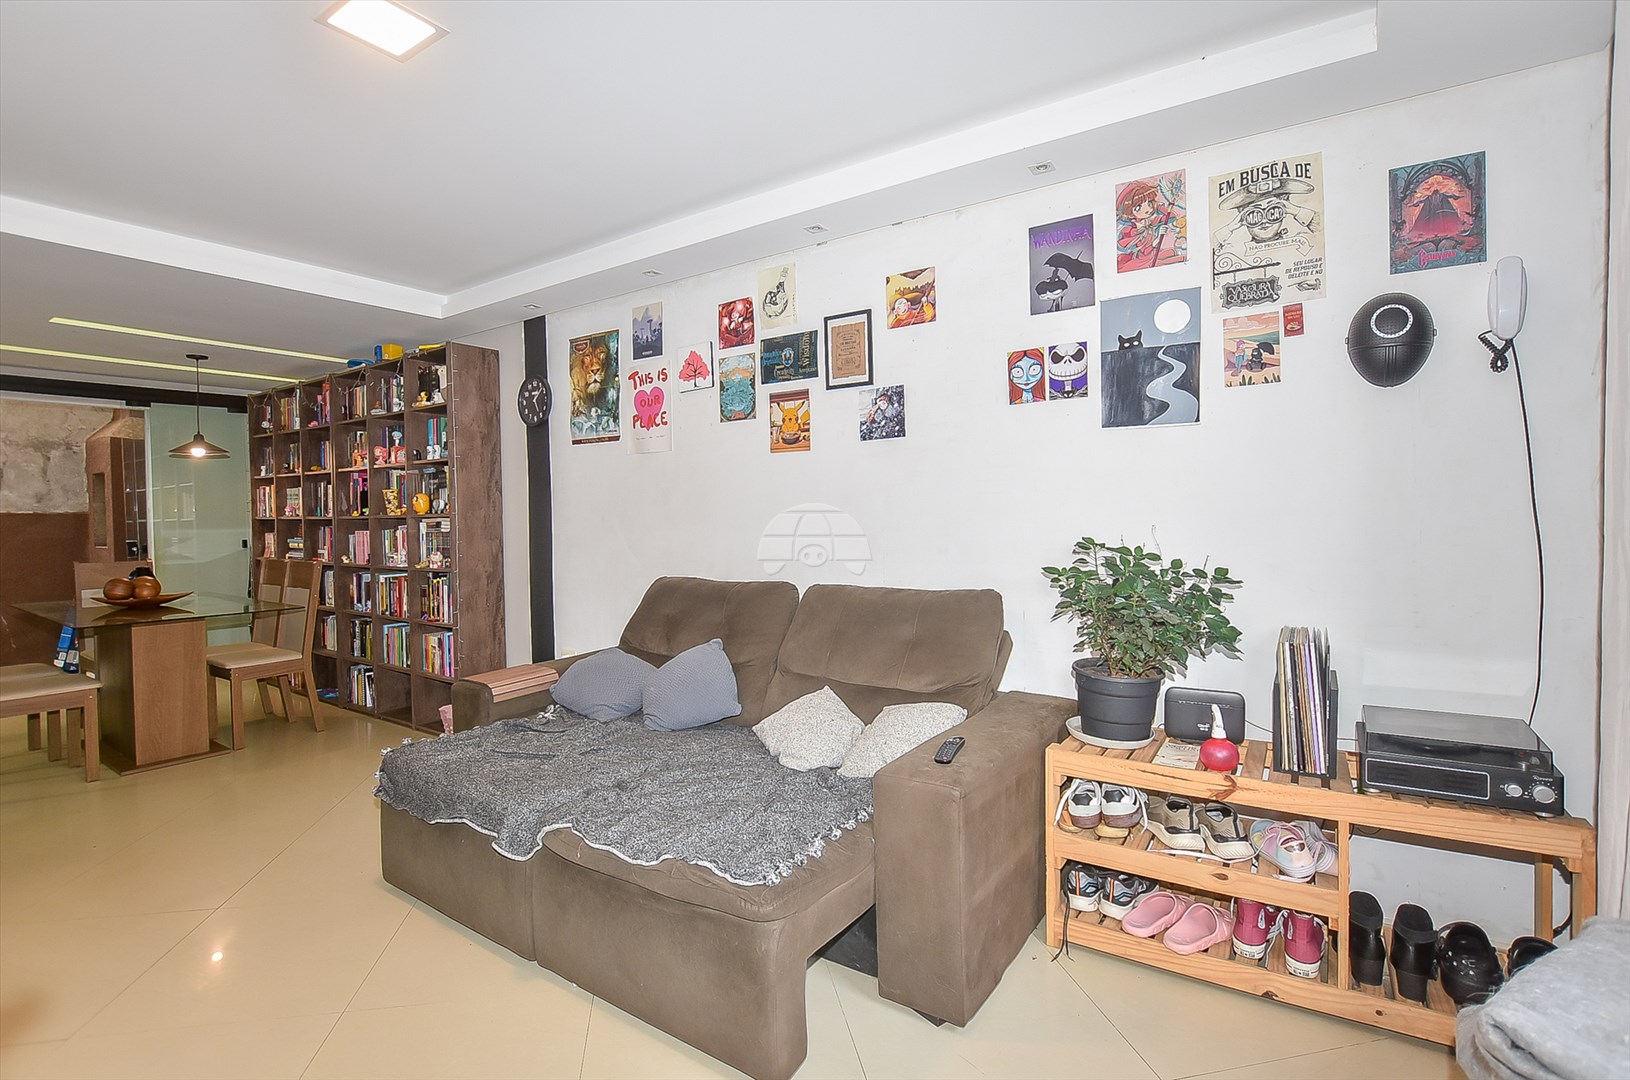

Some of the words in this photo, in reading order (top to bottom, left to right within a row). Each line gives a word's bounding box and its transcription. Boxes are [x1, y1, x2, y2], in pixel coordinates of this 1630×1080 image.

[1218, 178, 1235, 198] EM
[1239, 161, 1291, 187] BUSCA
[1295, 162, 1311, 179] DE
[1304, 256, 1323, 265] LUGAR
[628, 370, 654, 390] THIS
[657, 367, 668, 382] IS
[640, 394, 661, 408] OUR
[632, 410, 668, 430] PLACE
